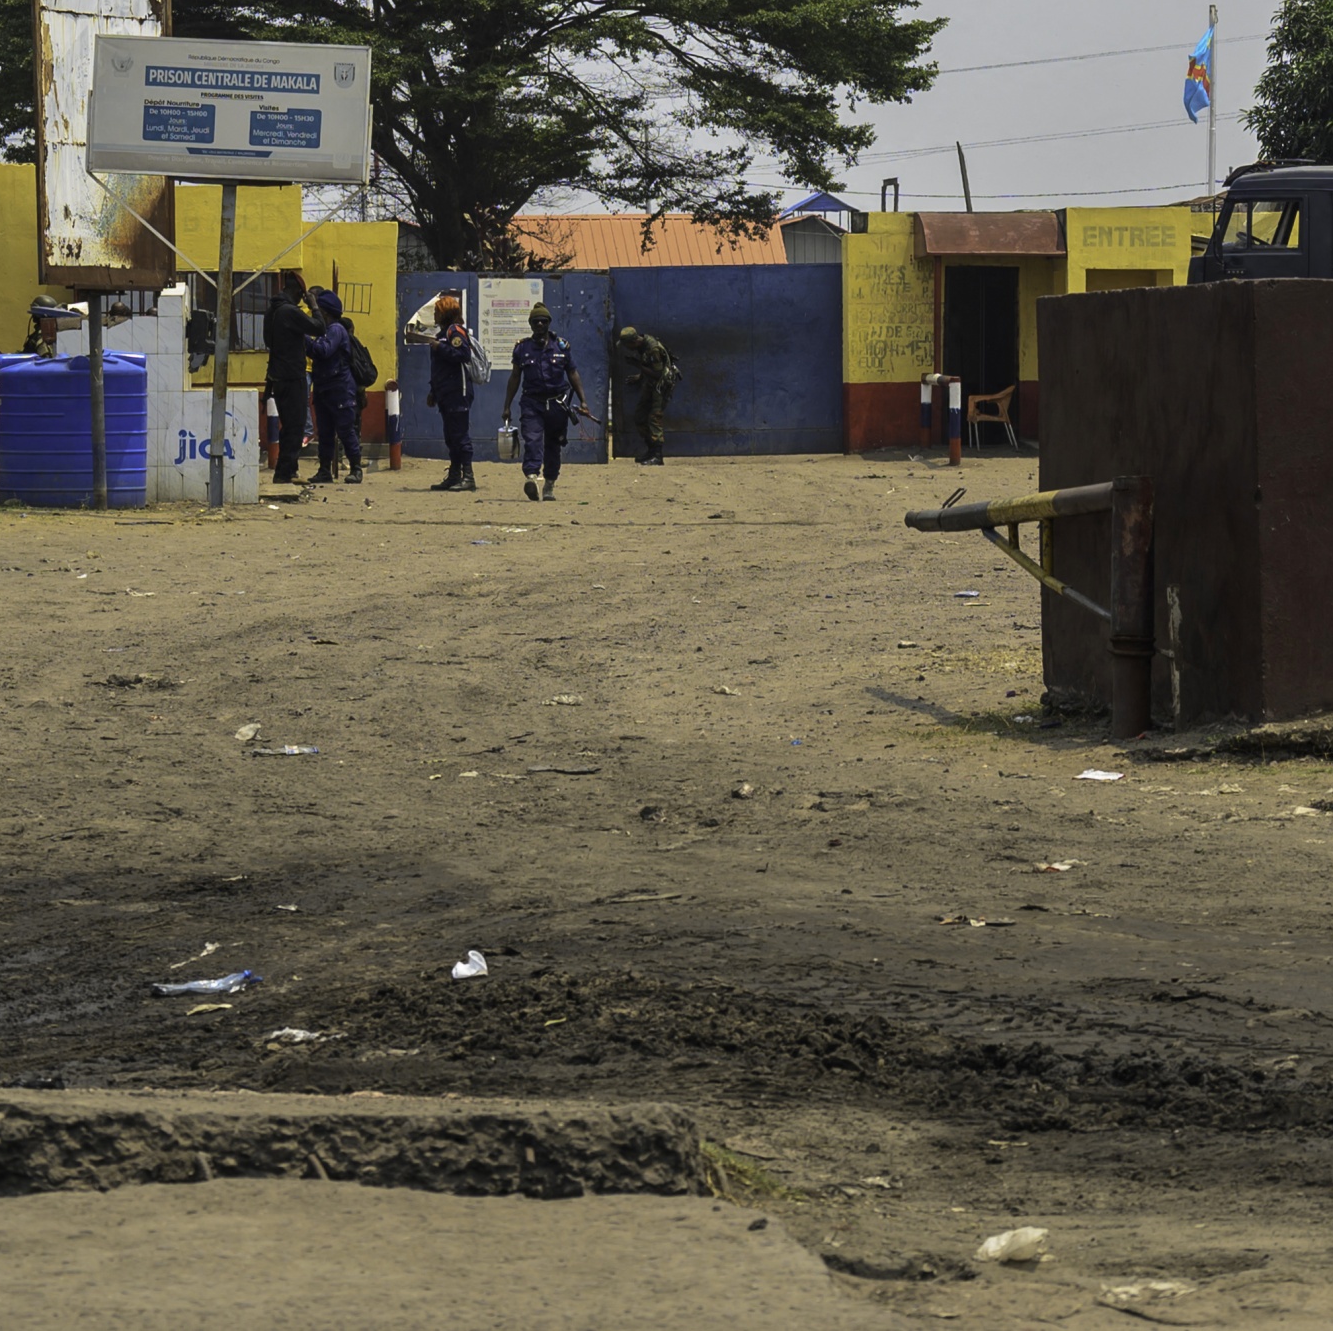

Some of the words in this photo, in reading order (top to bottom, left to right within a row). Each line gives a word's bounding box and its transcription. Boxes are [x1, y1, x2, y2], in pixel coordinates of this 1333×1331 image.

[149, 69, 191, 84] PRISON
[194, 71, 251, 87] CENTRALE
[254, 74, 268, 88] DE
[270, 75, 317, 91] MAKALA
[271, 138, 306, 146] Dimanche
[287, 131, 317, 139] Vendredi
[1083, 225, 1175, 247] ENTREE
